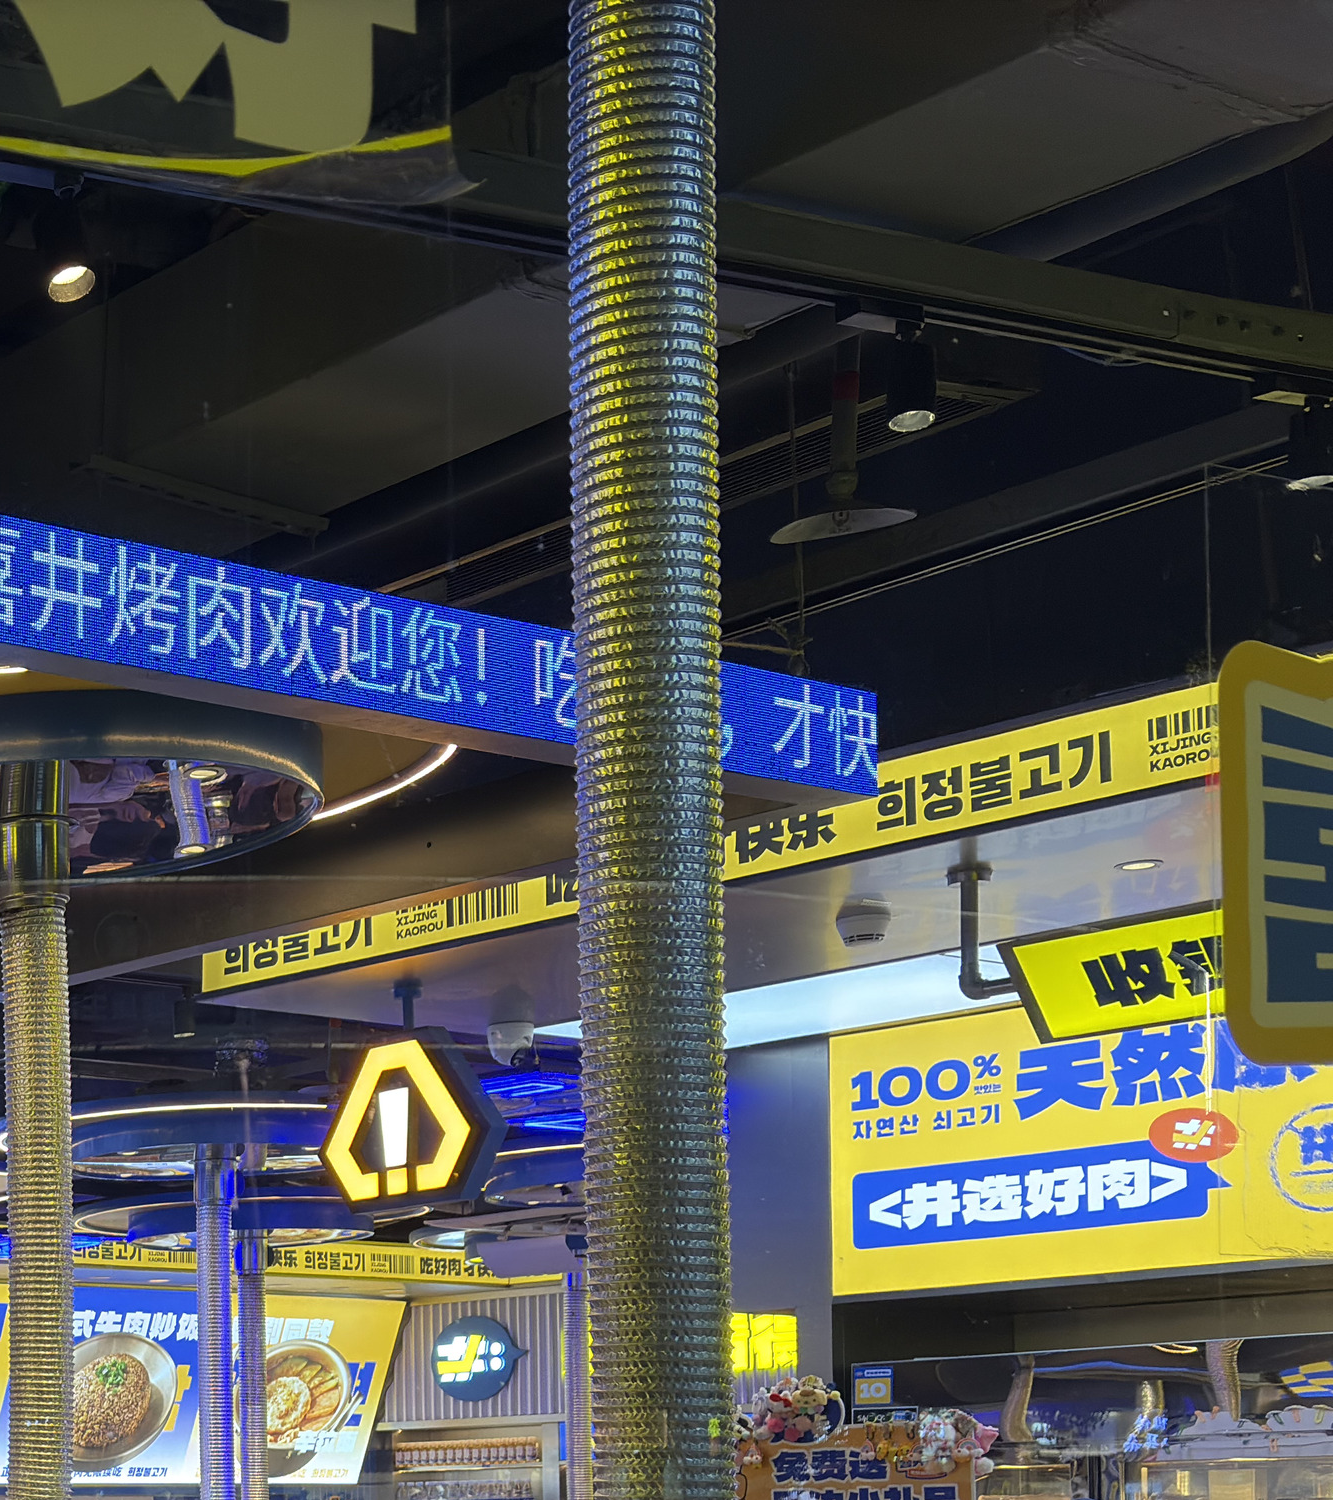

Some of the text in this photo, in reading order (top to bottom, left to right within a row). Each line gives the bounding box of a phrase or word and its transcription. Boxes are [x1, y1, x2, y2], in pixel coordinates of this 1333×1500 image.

[876, 731, 1112, 832] 희정불고기
[396, 909, 437, 927] XIJING
[396, 922, 444, 940] KAOROU
[852, 1102, 1001, 1140] 자연산 쇠고기
[859, 1382, 887, 1399] 10
